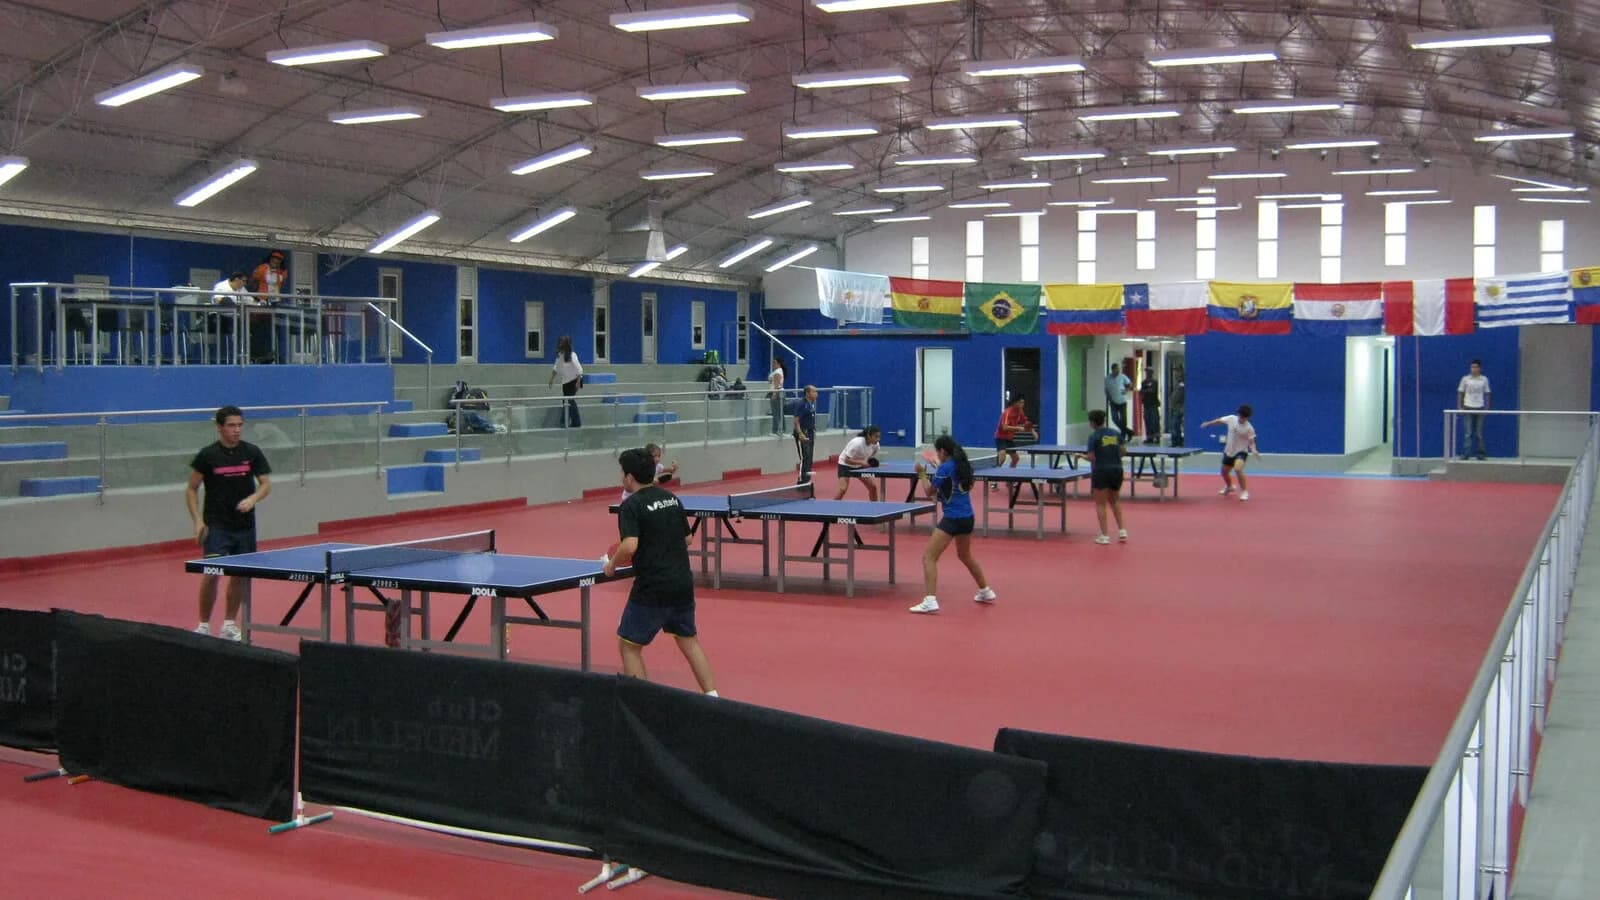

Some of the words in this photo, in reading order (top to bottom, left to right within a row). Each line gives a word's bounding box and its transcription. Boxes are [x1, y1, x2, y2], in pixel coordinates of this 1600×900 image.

[837, 517, 857, 525] JOOLA
[203, 566, 225, 576] JOOLA
[580, 577, 595, 587] JOOLA
[472, 587, 497, 597] JOOLA
